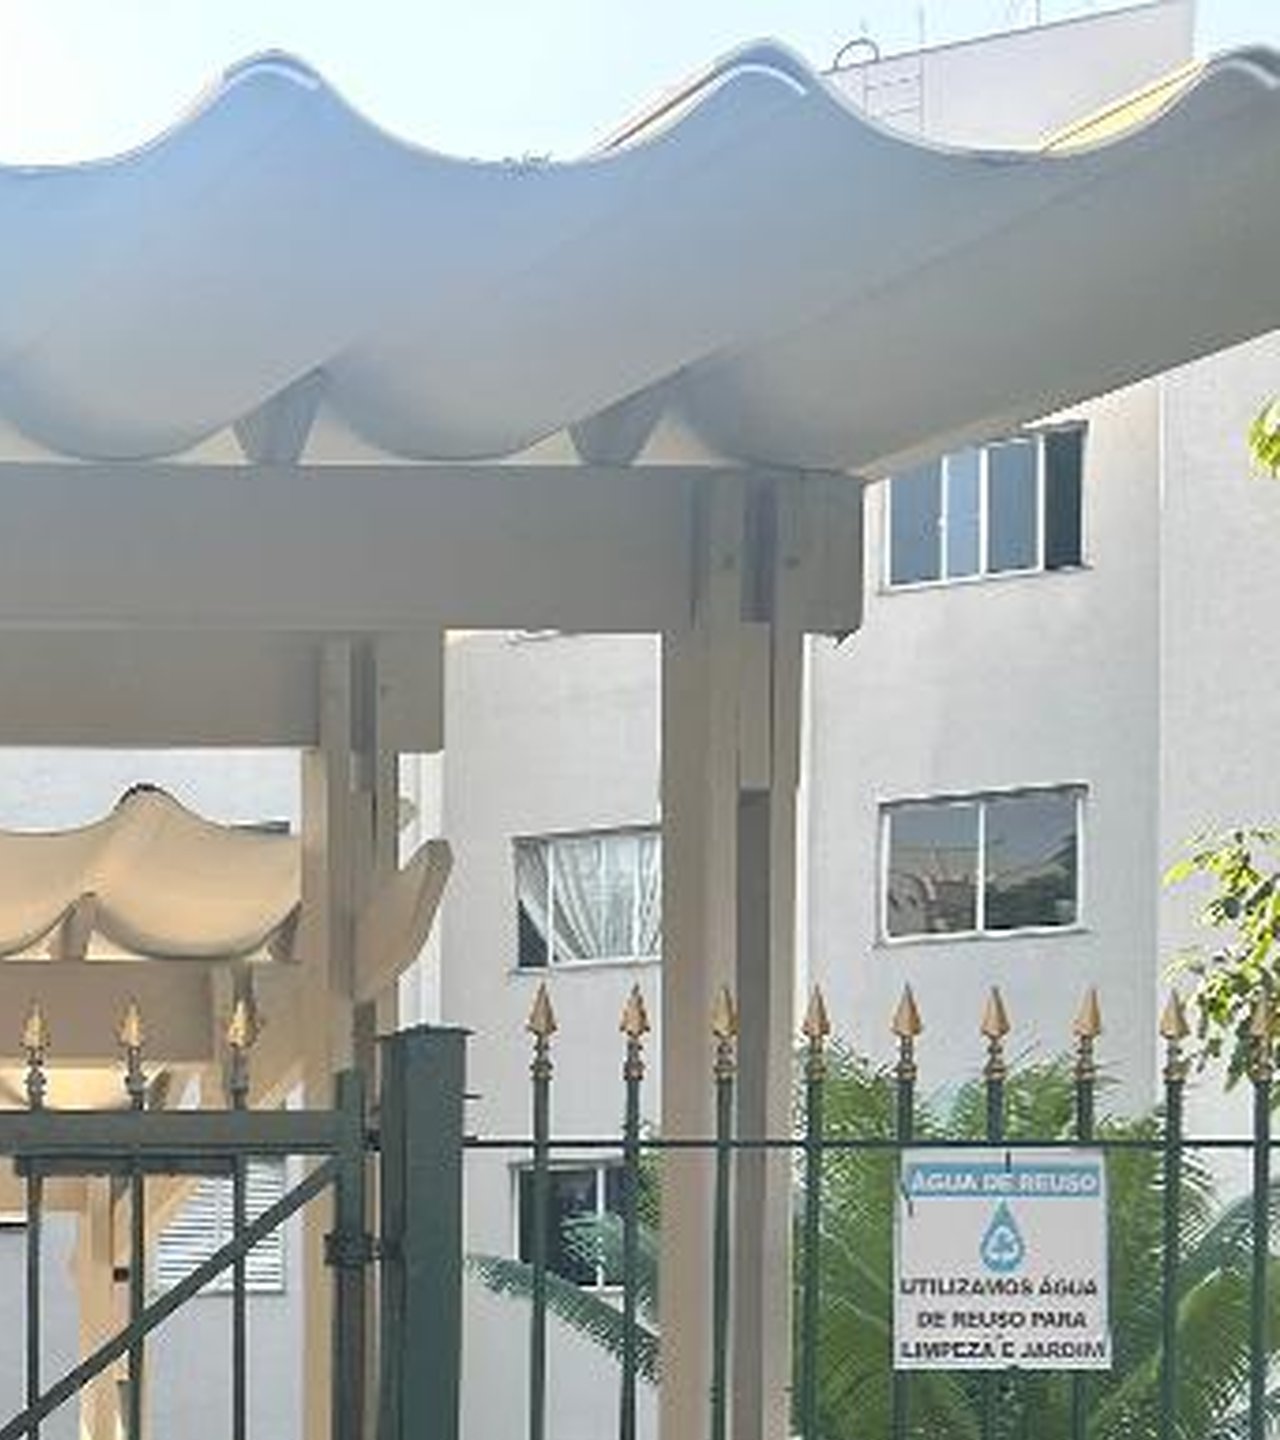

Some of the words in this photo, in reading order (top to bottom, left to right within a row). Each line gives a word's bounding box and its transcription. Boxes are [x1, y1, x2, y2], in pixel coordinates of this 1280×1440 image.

[1019, 1174, 1098, 1192] REUSO
[900, 1278, 1034, 1296] UTILIZAMOS
[918, 1312, 946, 1329] DE
[952, 1312, 1026, 1329] REUSO
[1031, 1312, 1087, 1329] PARA
[900, 1341, 996, 1359] LIMPEZA
[1001, 1341, 1015, 1359] E
[1020, 1341, 1106, 1359] JARDIM
